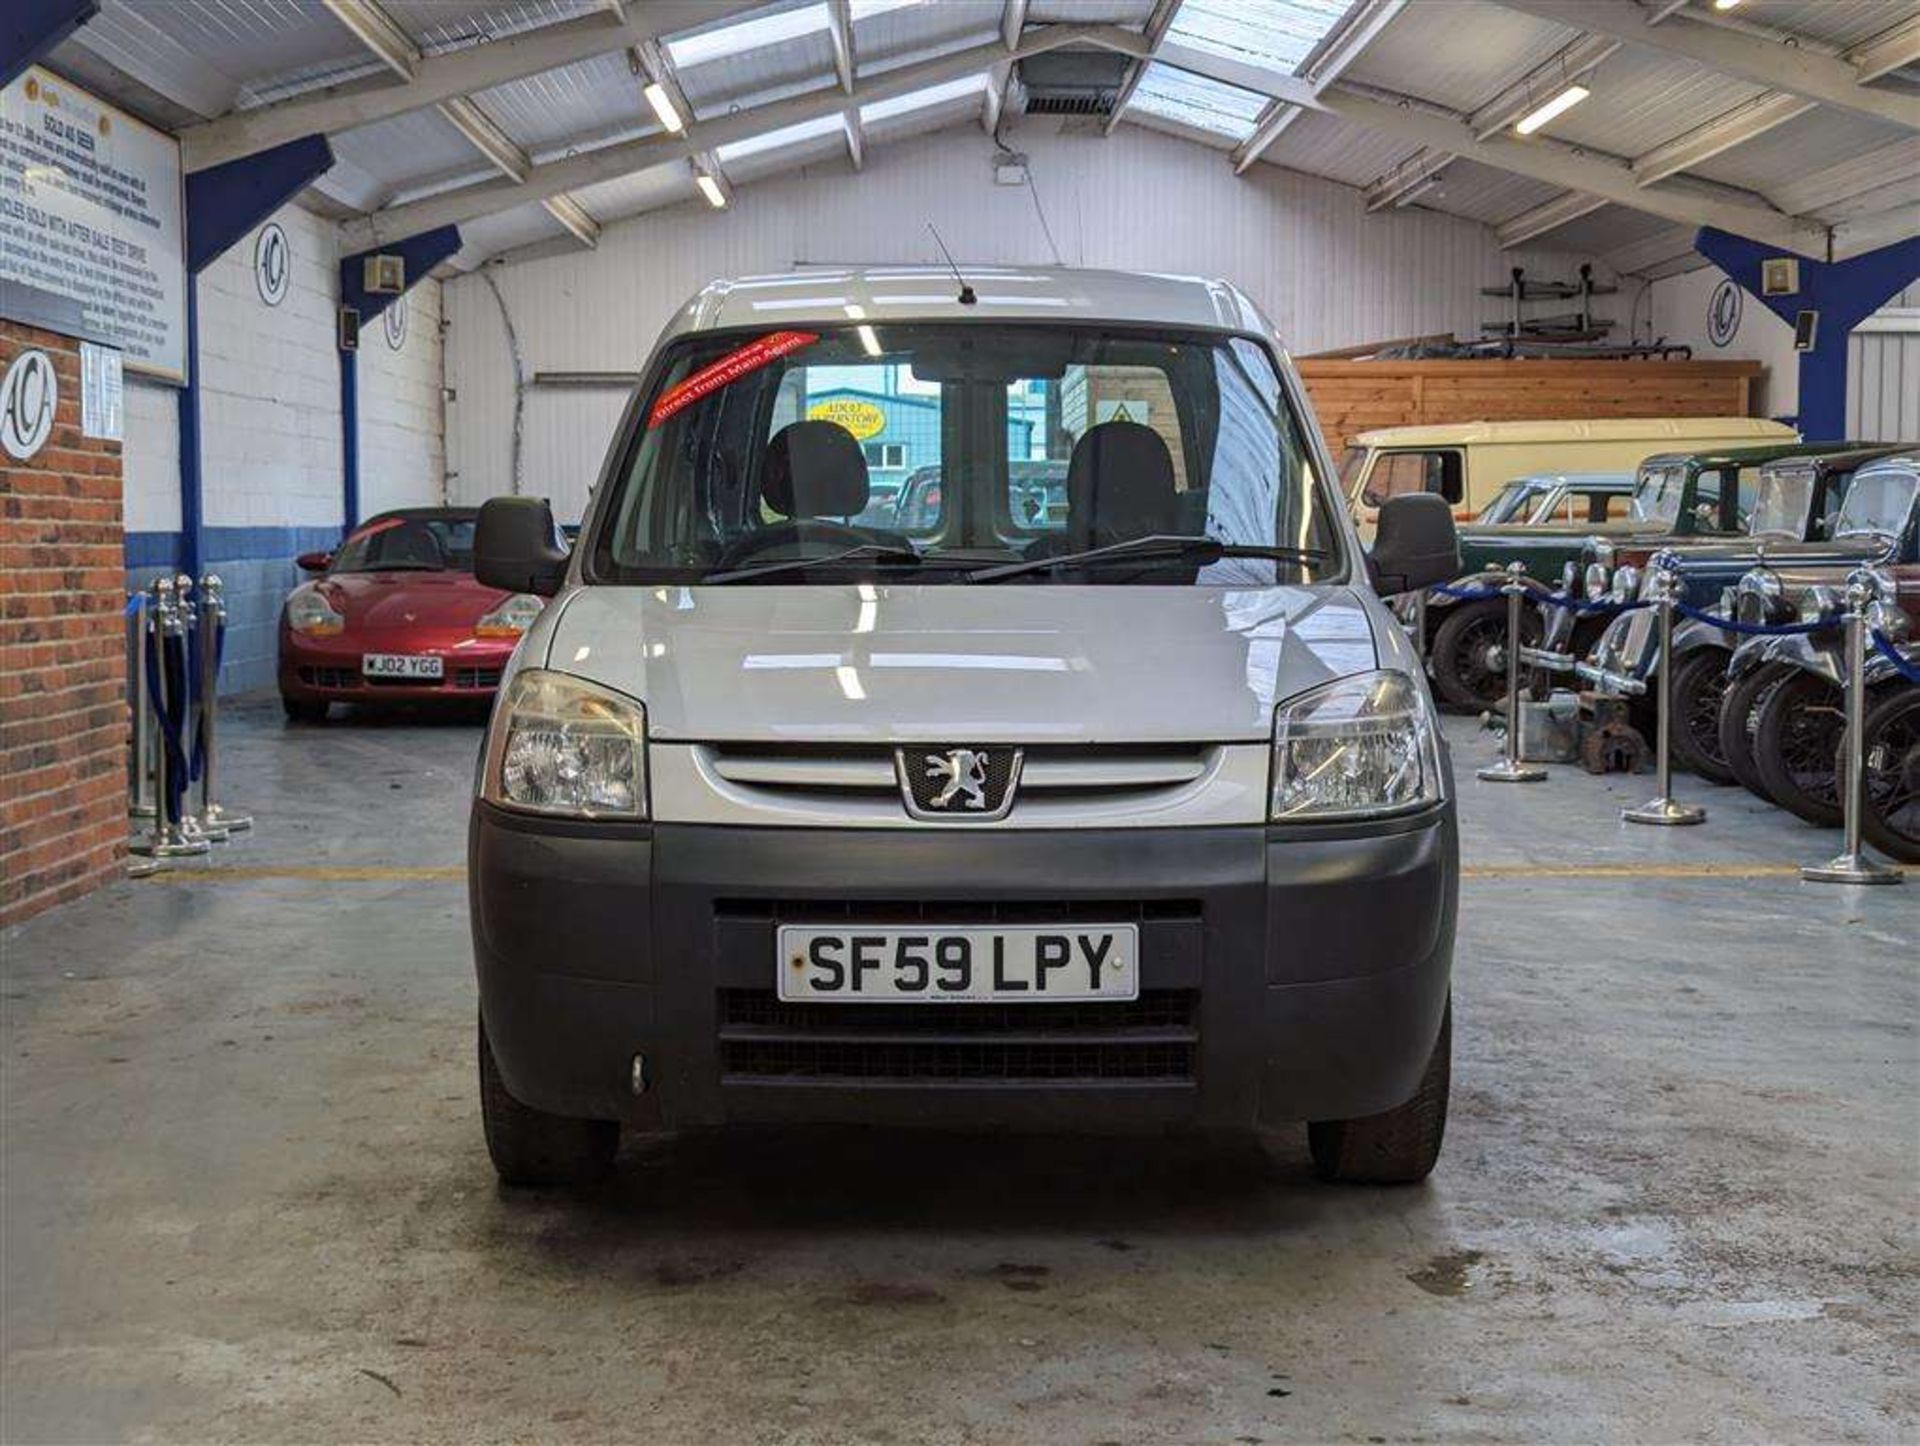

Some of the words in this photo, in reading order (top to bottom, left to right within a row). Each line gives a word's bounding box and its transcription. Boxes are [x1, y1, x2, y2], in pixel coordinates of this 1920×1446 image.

[728, 355, 761, 377] Main
[809, 936, 972, 991] SF59
[993, 935, 1113, 991] LPY
